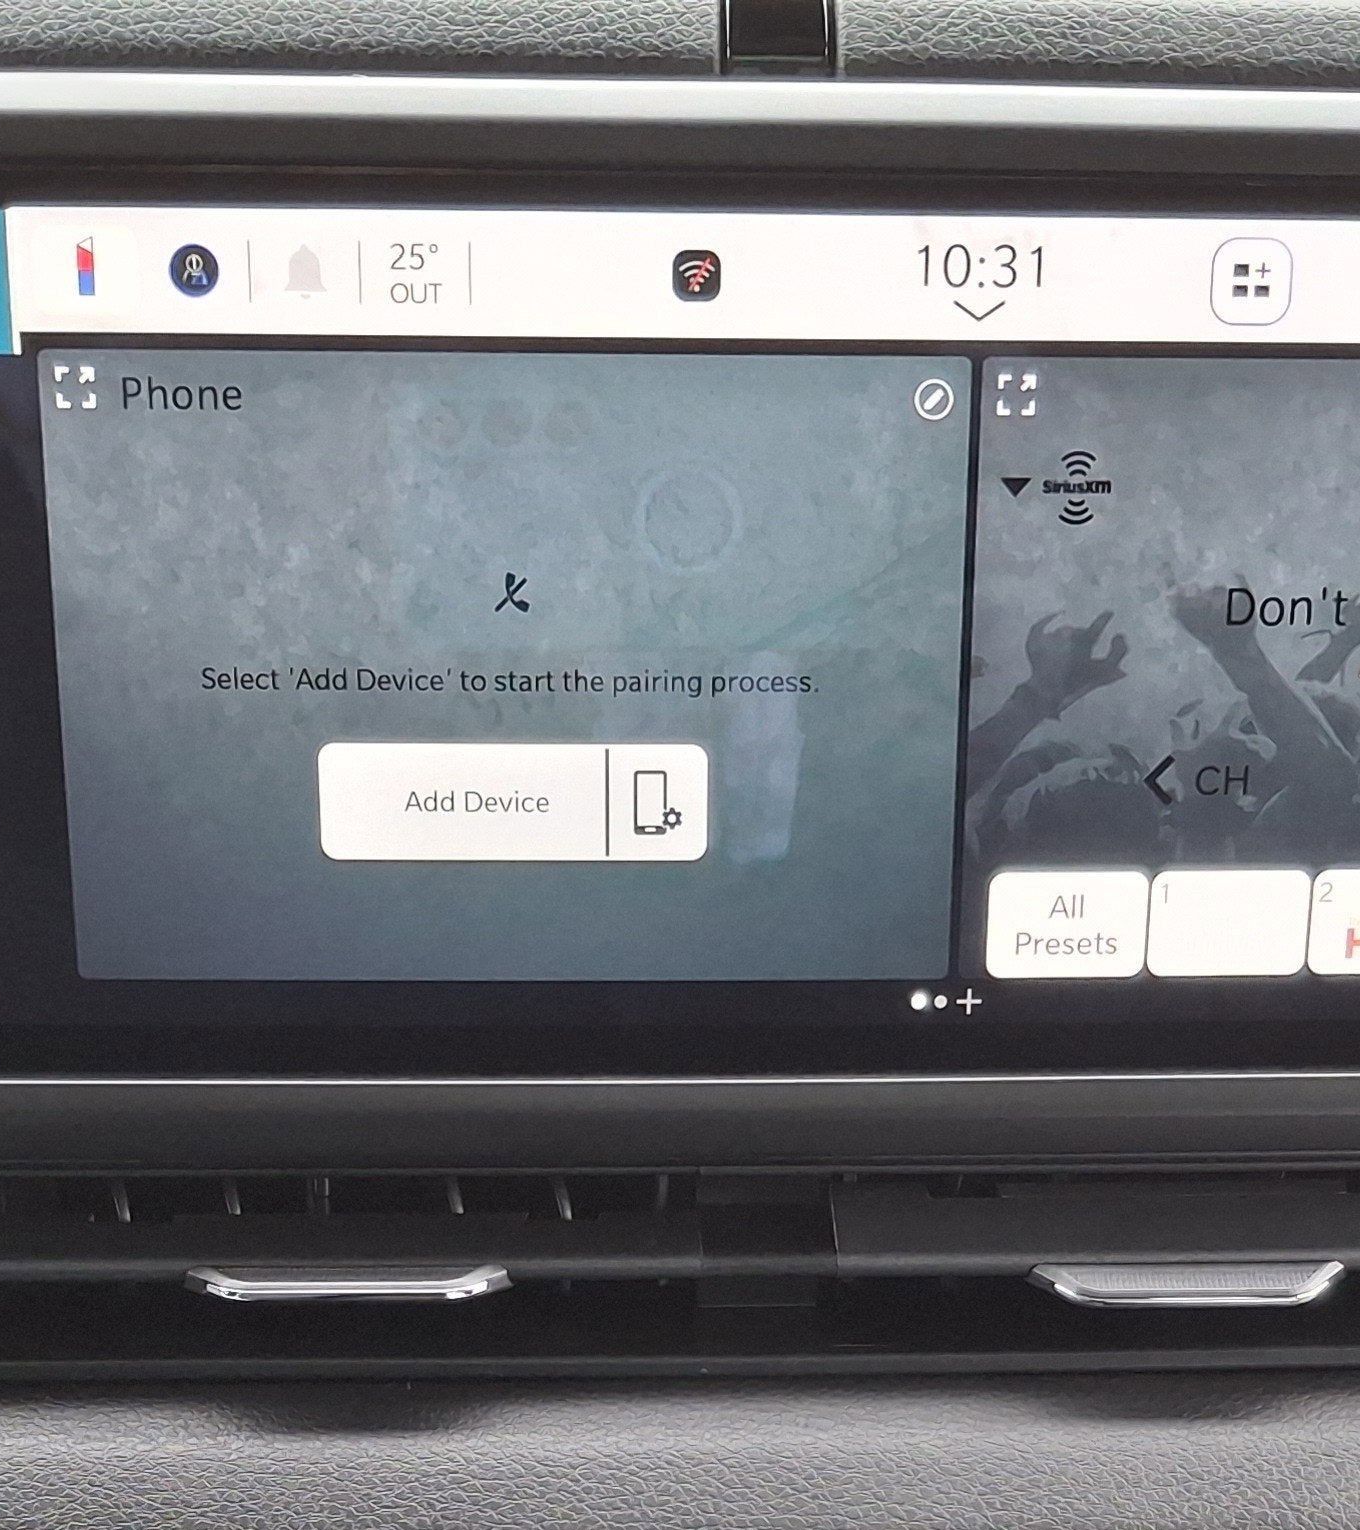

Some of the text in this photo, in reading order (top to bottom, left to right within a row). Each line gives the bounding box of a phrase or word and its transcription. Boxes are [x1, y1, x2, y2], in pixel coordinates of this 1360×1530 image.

[389, 242, 438, 270] 25°
[918, 243, 1045, 289] 10:31
[390, 283, 442, 305] OUT
[120, 377, 243, 411] Phone
[1224, 586, 1349, 630] Don't
[201, 667, 820, 699] Select 'Add Device' to start the pairing process.
[1195, 765, 1249, 797] CH
[404, 791, 550, 814] Add Device
[1161, 884, 1169, 904] 1
[1319, 882, 1333, 902] 2
[1048, 894, 1085, 919] All
[1015, 932, 1117, 956] Presets
